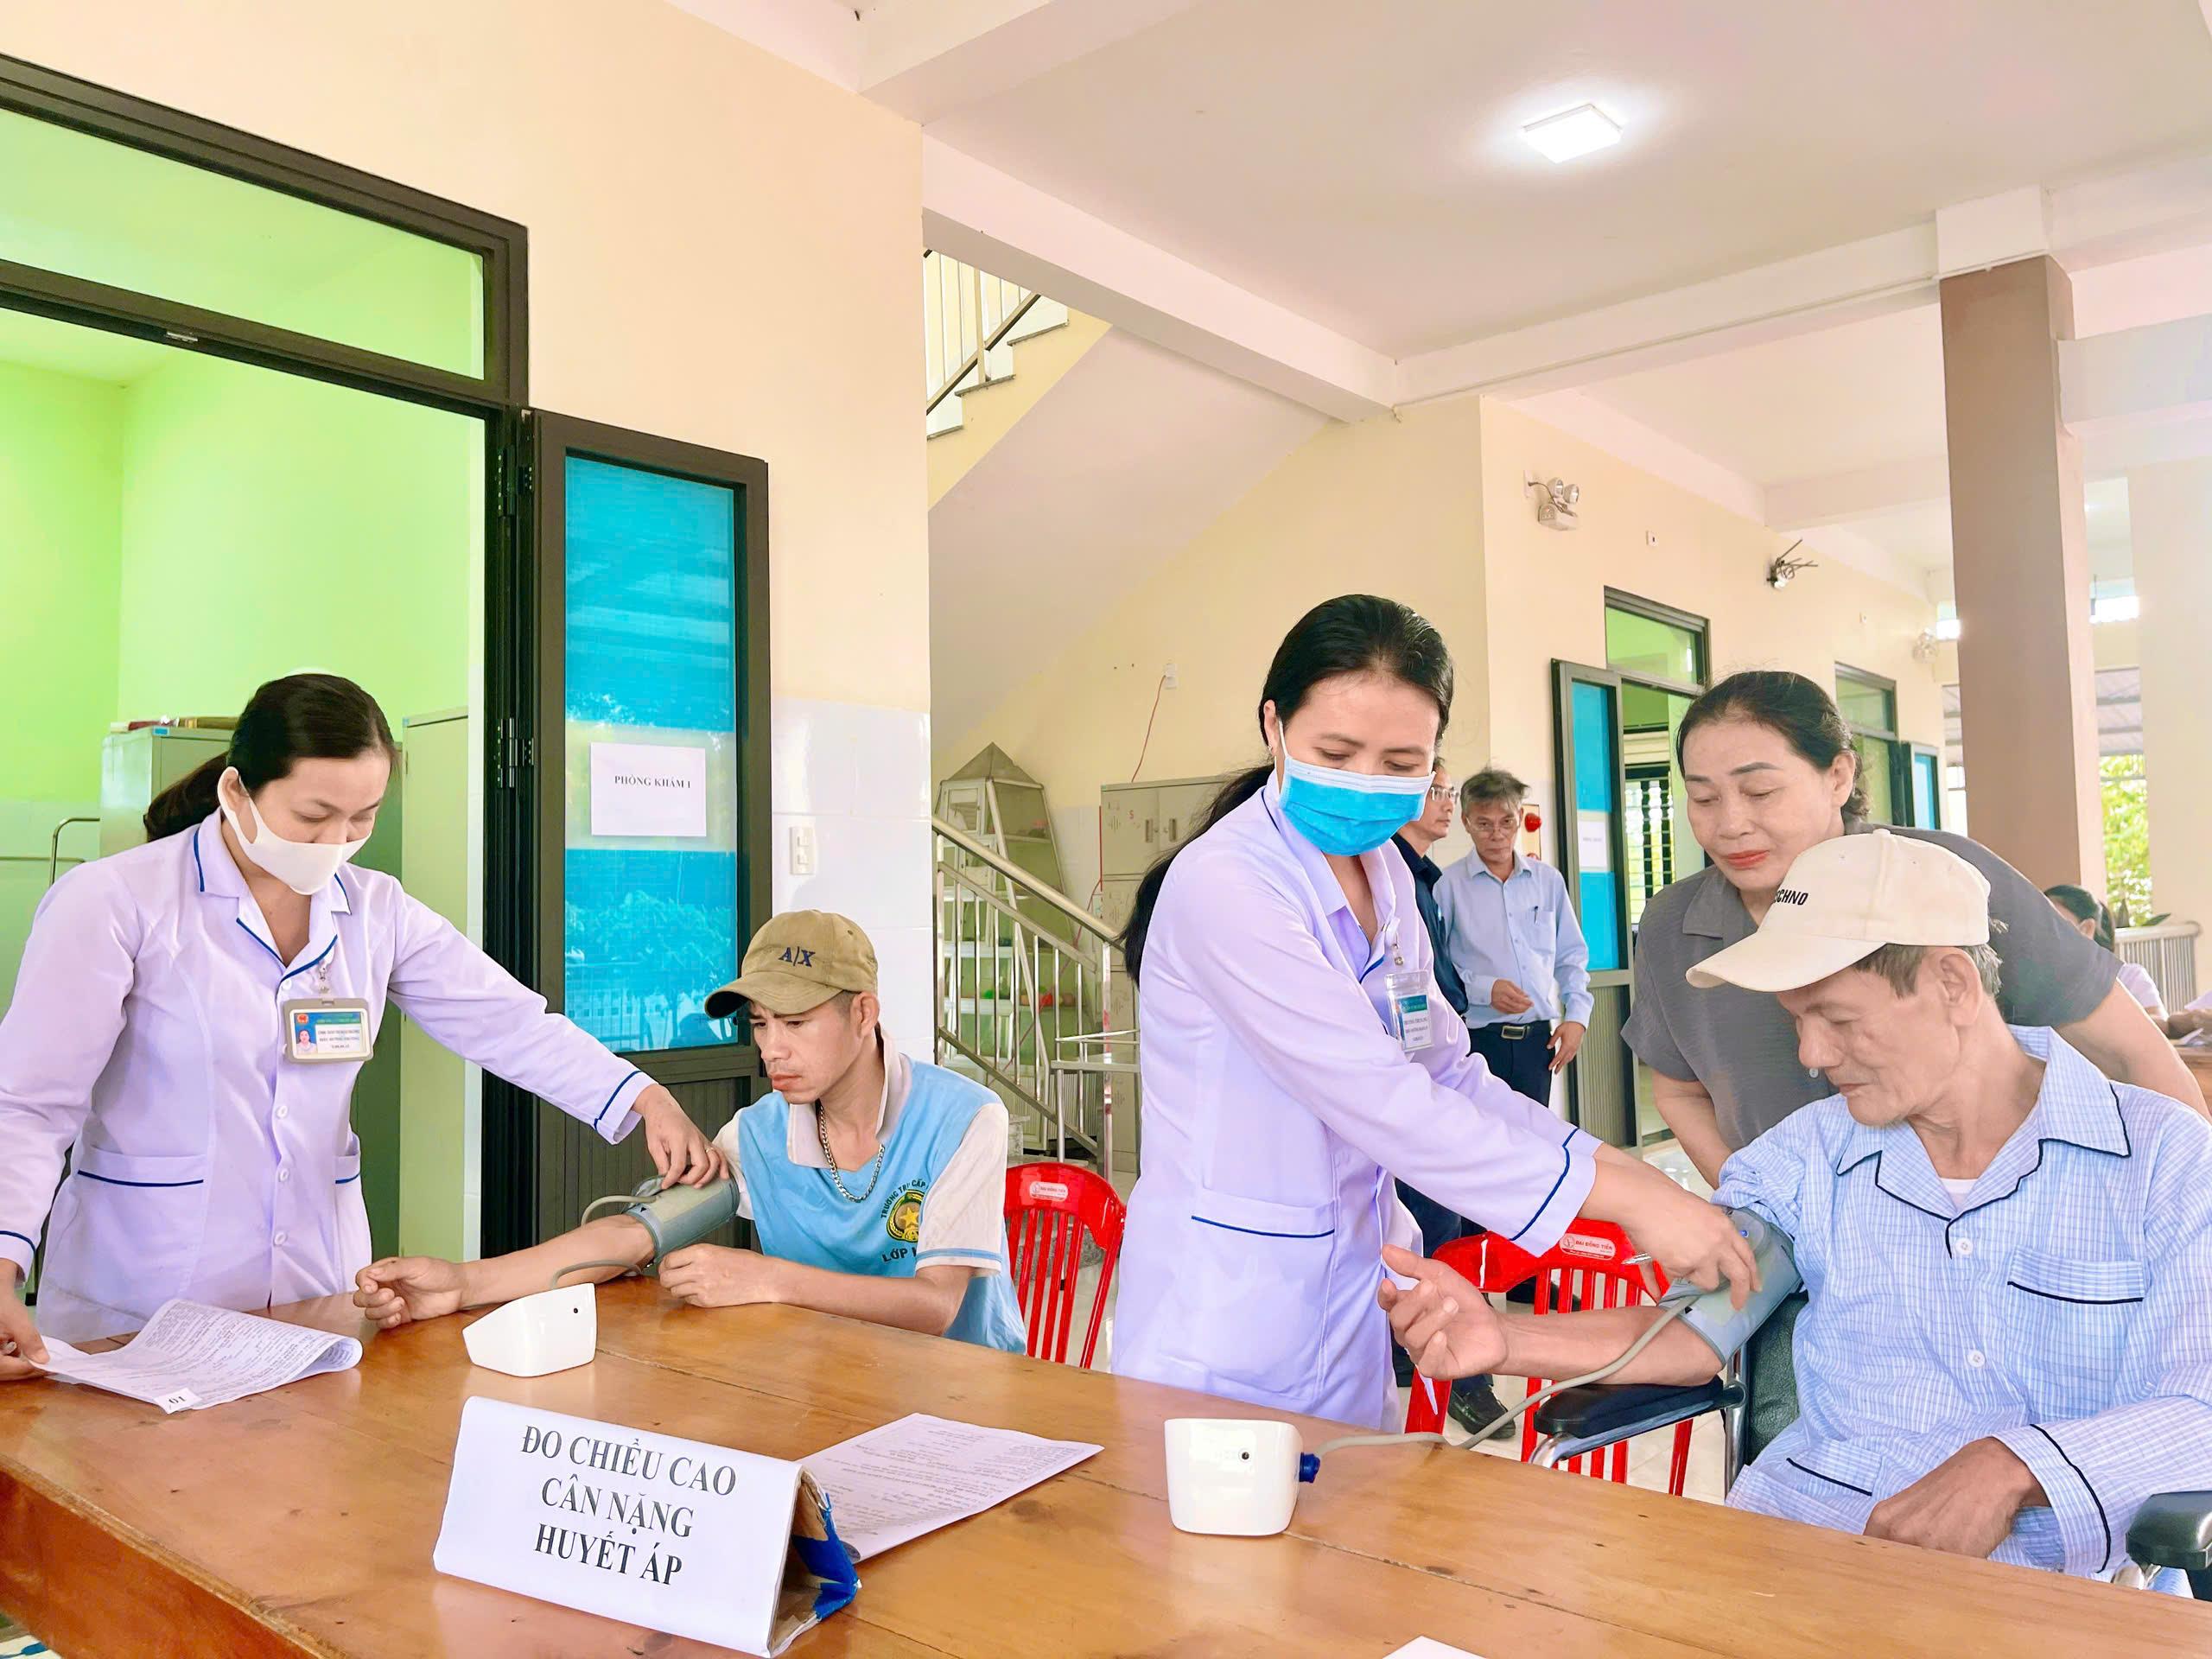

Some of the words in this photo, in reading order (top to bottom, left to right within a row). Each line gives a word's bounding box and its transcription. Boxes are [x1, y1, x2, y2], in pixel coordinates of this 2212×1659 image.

[614, 773, 652, 786] PHÒNG
[654, 776, 684, 788] KHÁM
[520, 1425, 562, 1459] ĐO
[569, 1437, 665, 1481] CHIỀU
[669, 1456, 737, 1497] CAO
[541, 1474, 604, 1517] CÂN
[607, 1491, 695, 1539] NẶNG
[534, 1522, 636, 1575] HUYẾT
[639, 1543, 683, 1586] ÁP
